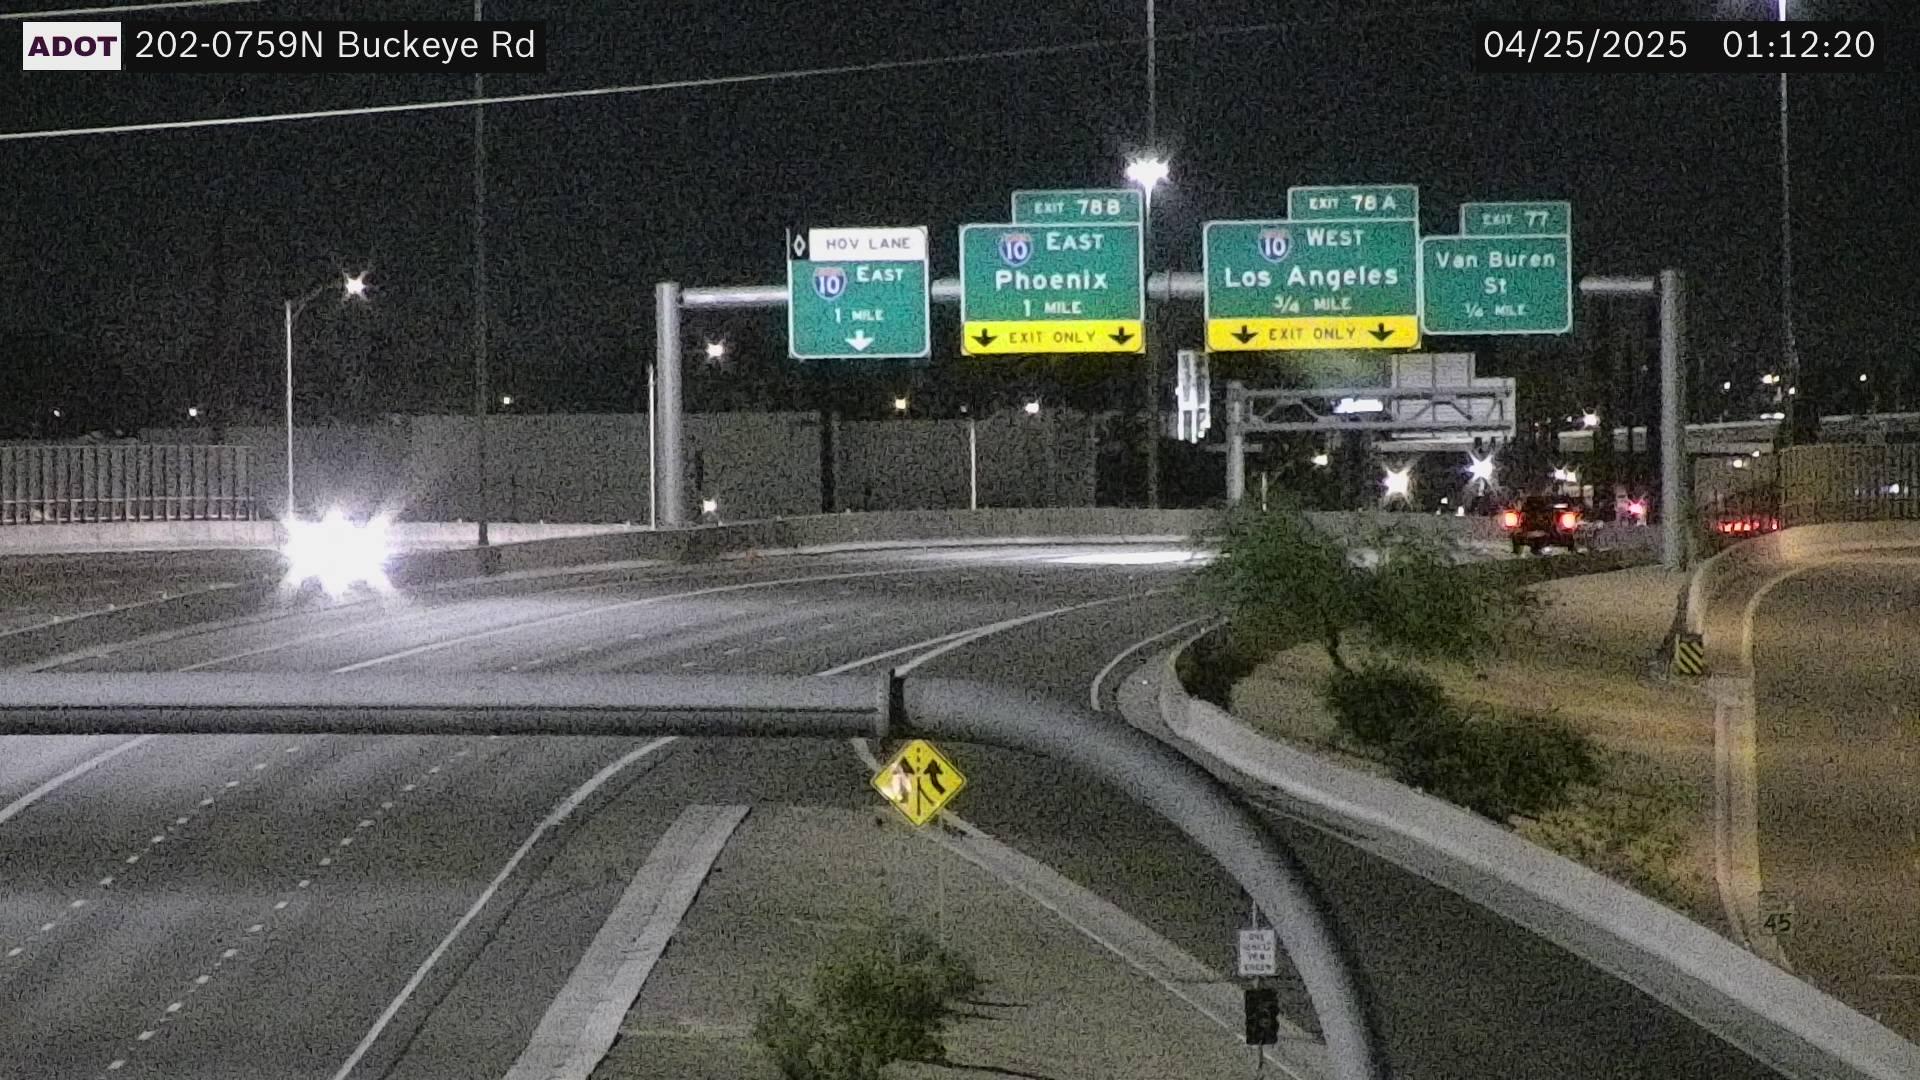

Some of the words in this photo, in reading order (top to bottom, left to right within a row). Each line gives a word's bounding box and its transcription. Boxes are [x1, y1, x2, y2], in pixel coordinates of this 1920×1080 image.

[1034, 202, 1064, 214] EXIT
[1309, 198, 1338, 210] EXIT
[1482, 213, 1513, 225] EXIT
[1525, 211, 1549, 229] 77
[826, 237, 860, 250] HOV
[869, 237, 910, 250] LANE
[1006, 240, 1026, 259] 10
[1046, 233, 1104, 251] EAST
[1263, 238, 1286, 257] 10
[1306, 229, 1364, 247] WEST
[1436, 252, 1477, 268] Van
[1490, 251, 1555, 267] Buren
[819, 278, 840, 294] 10
[856, 267, 904, 282] EAST
[995, 270, 1108, 291] Phoenix
[1225, 267, 1271, 288] Los
[1289, 265, 1398, 291] Angeles
[1485, 277, 1507, 294] St
[1023, 300, 1030, 317] 1
[1044, 302, 1081, 315] MILE
[1313, 297, 1352, 311] MILE
[1495, 303, 1527, 316] MILE
[834, 308, 841, 323] 1
[852, 310, 883, 321] MILE
[1009, 331, 1048, 344] EXIT
[1053, 331, 1096, 344] ONLY
[1269, 328, 1307, 341] EXIT
[1313, 327, 1355, 340] ONLY
[1763, 913, 1792, 932] 45
